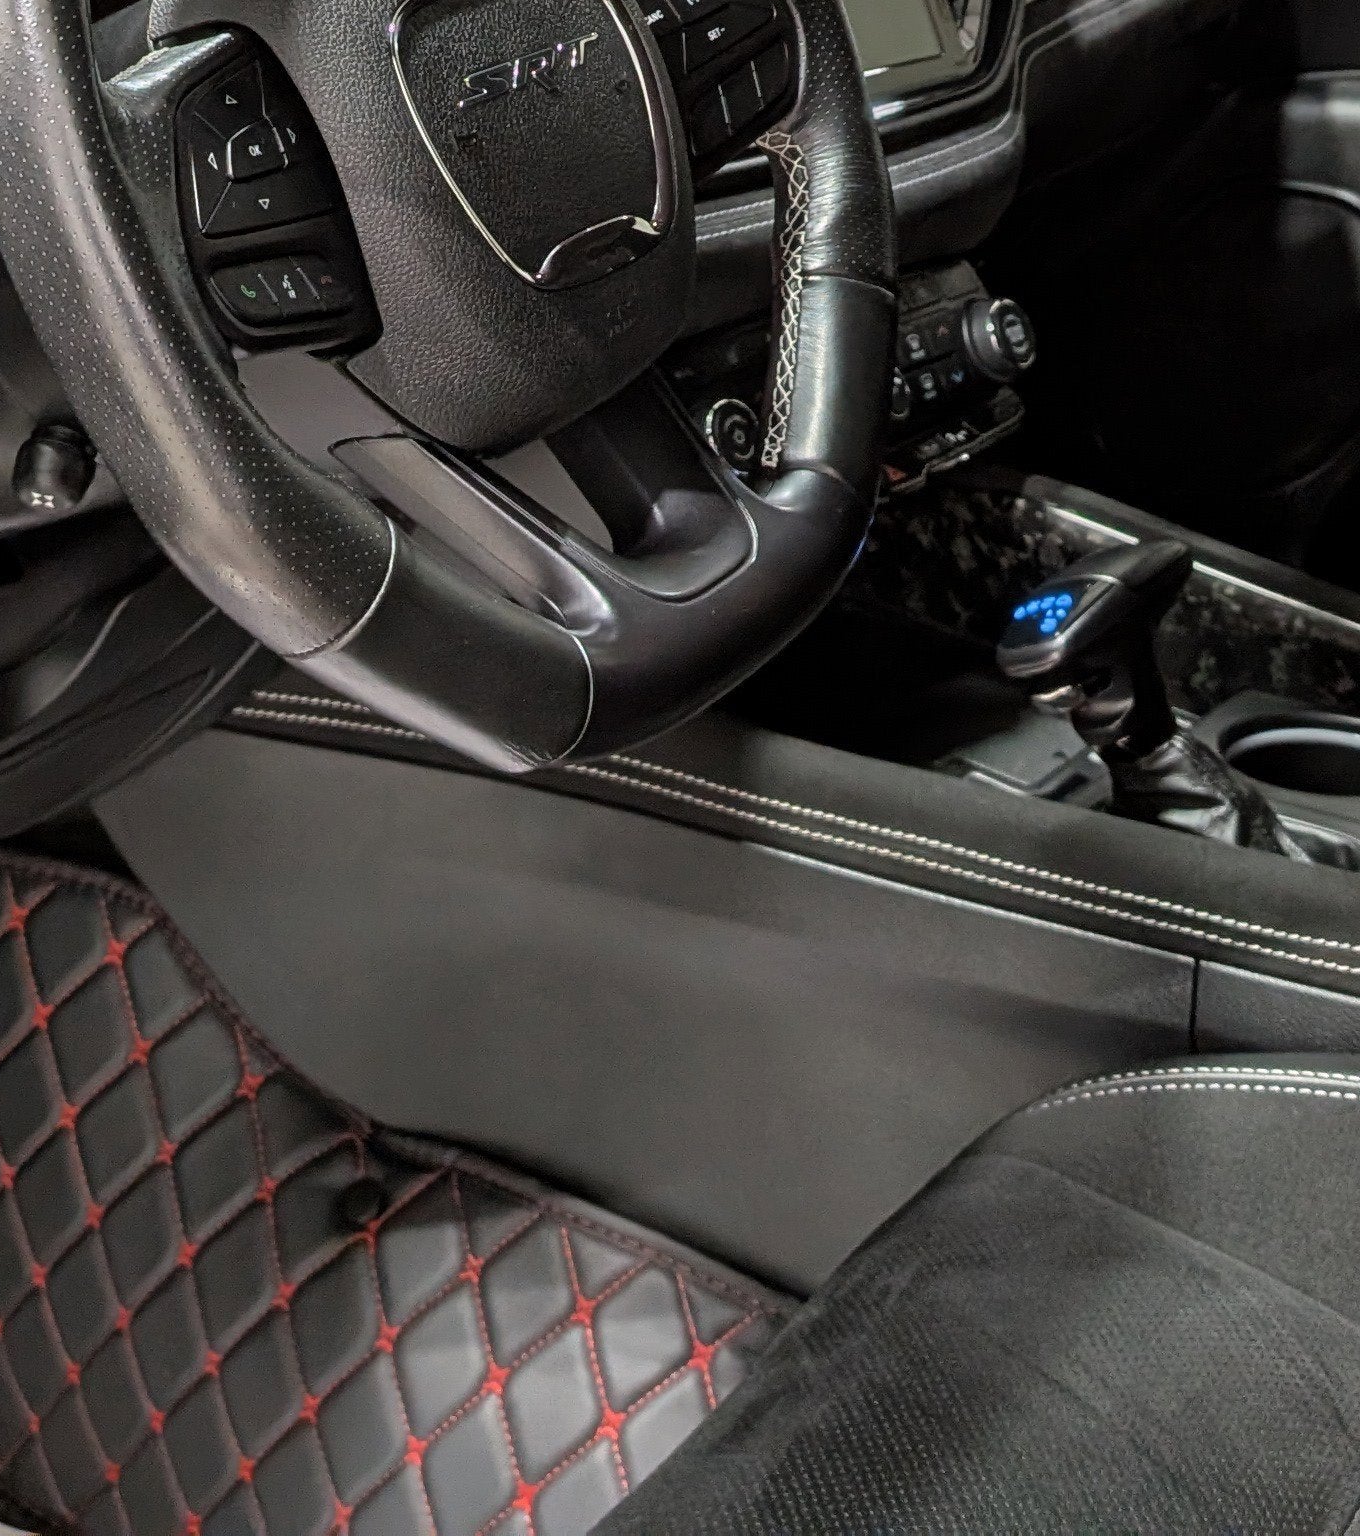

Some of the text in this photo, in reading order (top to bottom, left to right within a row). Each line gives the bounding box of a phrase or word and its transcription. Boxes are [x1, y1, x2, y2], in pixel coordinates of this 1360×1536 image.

[644, 9, 664, 25] ANC
[456, 31, 599, 109] SRT
[248, 144, 263, 157] OK
